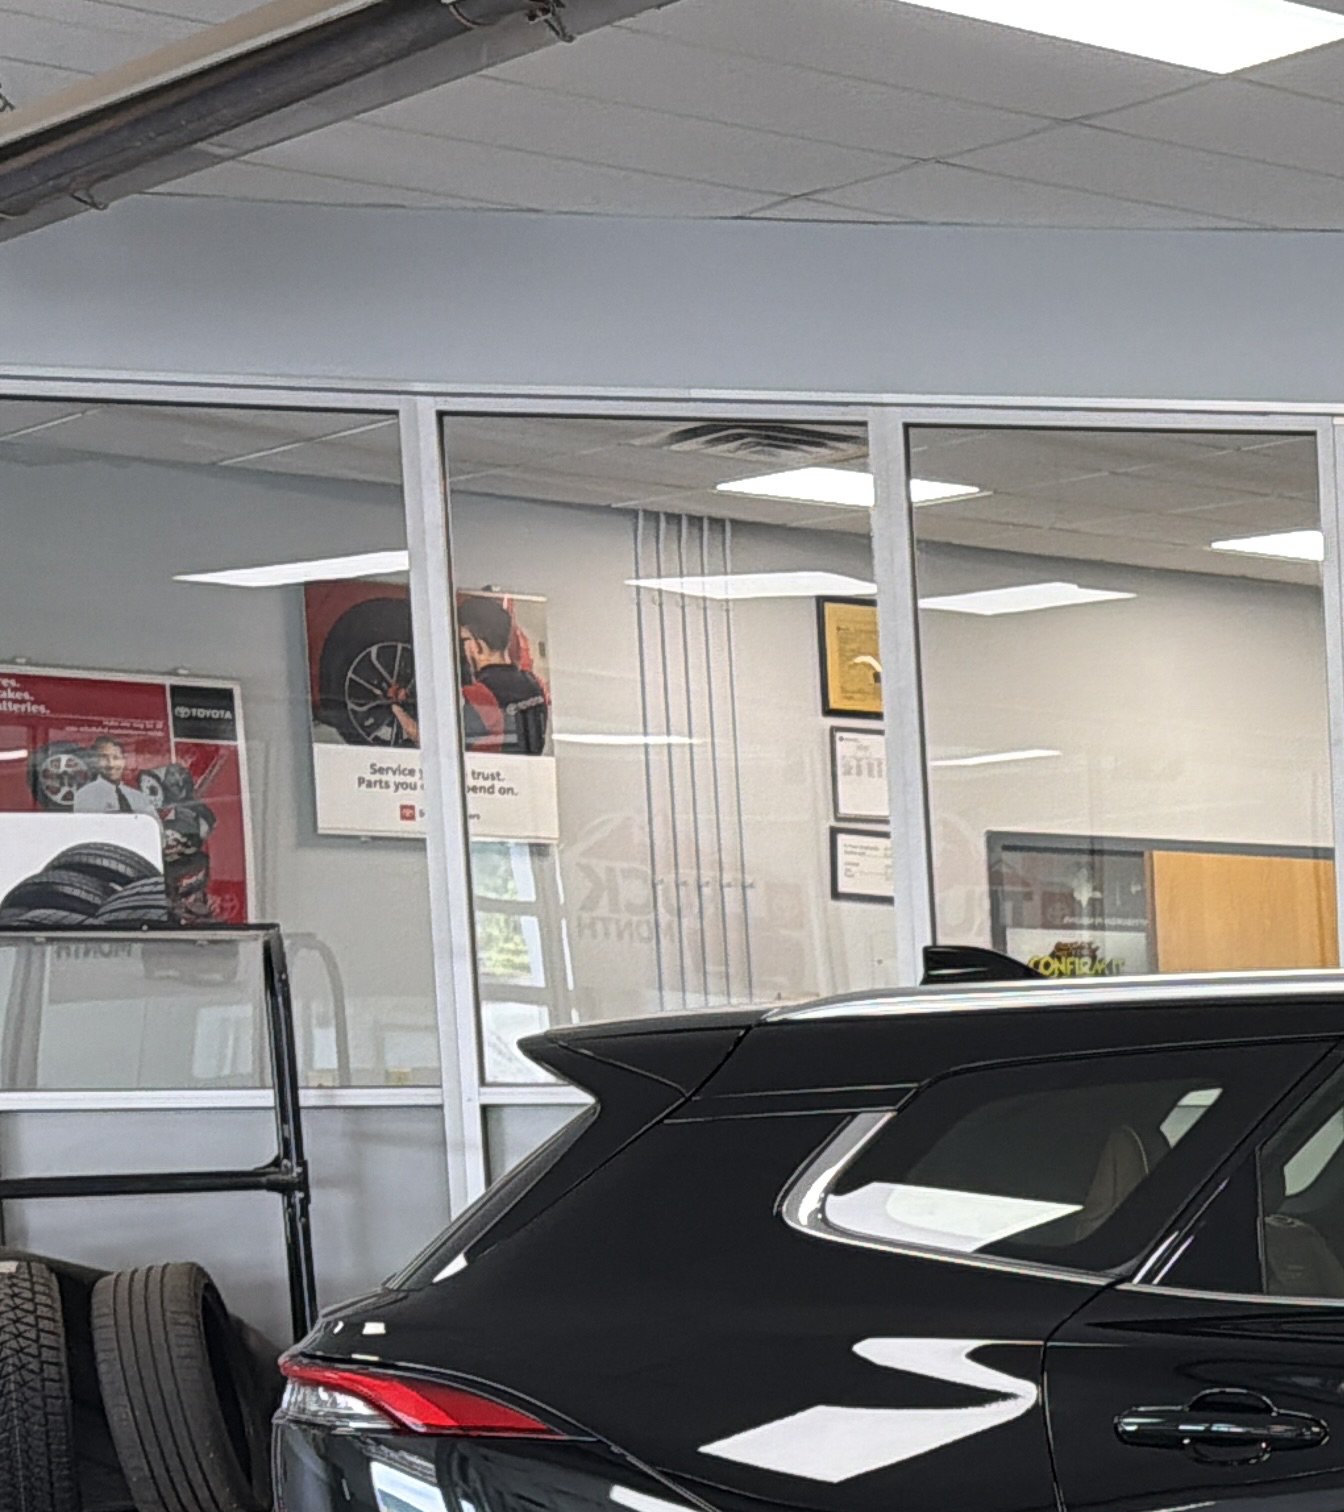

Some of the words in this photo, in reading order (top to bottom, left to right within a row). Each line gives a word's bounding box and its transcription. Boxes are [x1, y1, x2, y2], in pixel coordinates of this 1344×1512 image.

[190, 708, 233, 720] TOYOTA
[369, 762, 416, 778] Service
[471, 769, 505, 782] trust.
[357, 776, 391, 791] Parts
[393, 779, 417, 793] you
